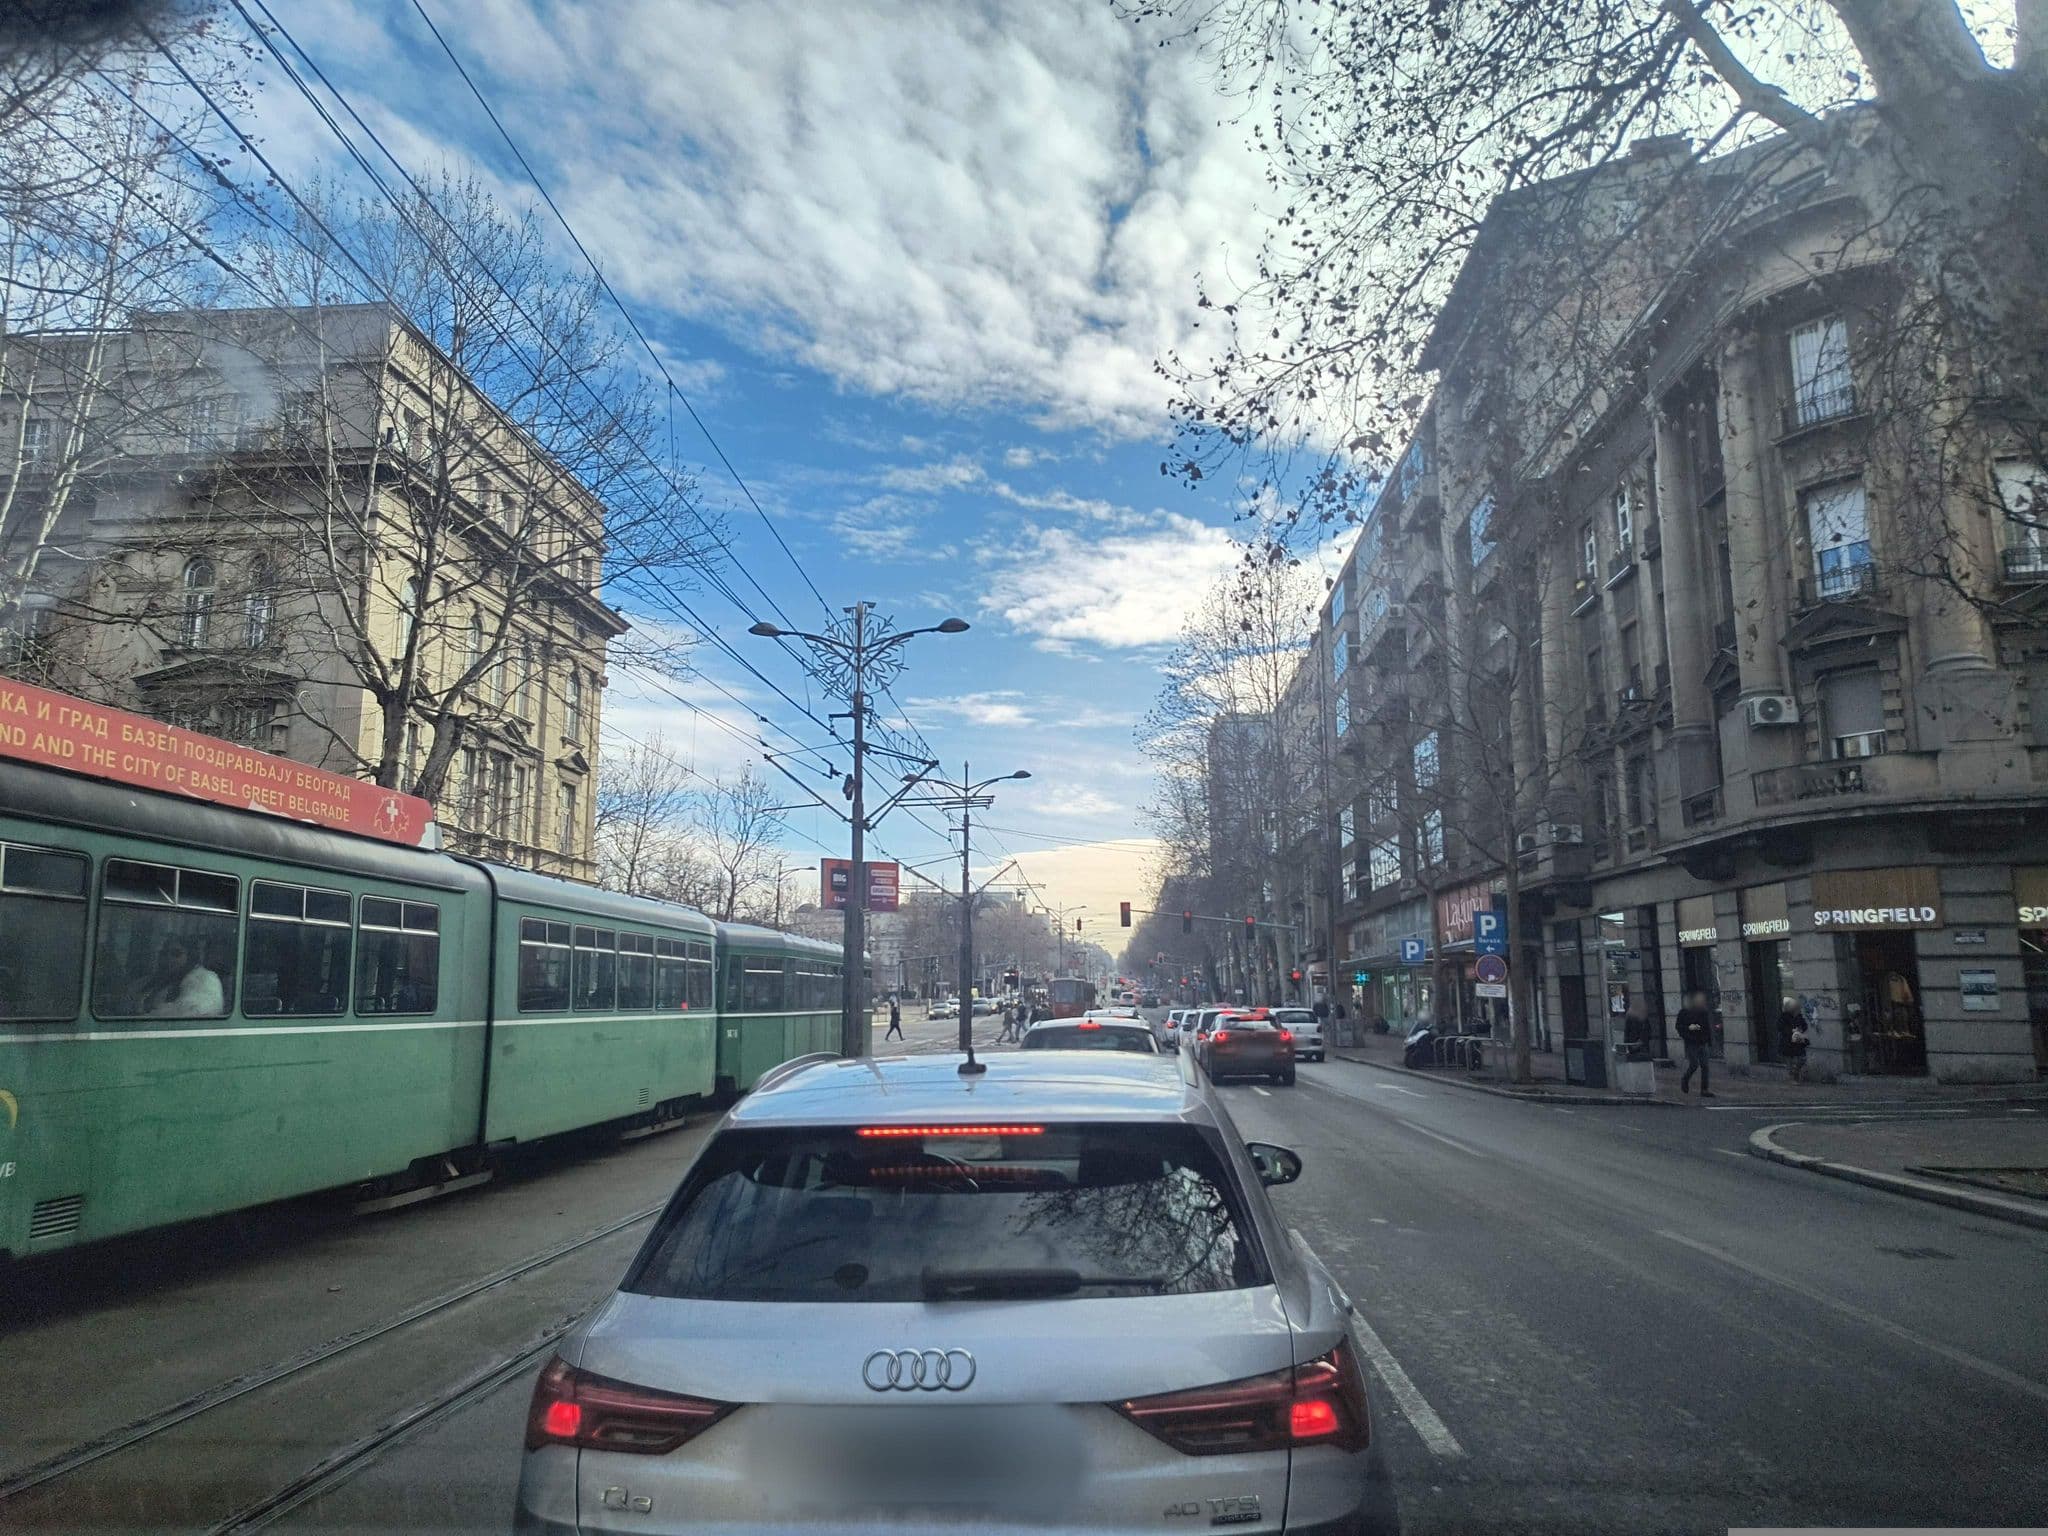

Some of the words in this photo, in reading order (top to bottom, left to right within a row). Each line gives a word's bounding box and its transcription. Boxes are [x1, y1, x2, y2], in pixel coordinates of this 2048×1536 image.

[37, 700, 51, 721] И
[58, 706, 109, 740] ГРАД
[122, 724, 178, 754] БАЗЕЛ
[184, 740, 293, 784] ПОЗДРАВЉАЈУ
[296, 772, 352, 803] БЕОГРАД
[32, 732, 75, 758] AND
[81, 743, 117, 769] THE
[123, 754, 161, 778] CITY
[165, 764, 187, 783] OF
[191, 770, 237, 797] BASEL
[241, 783, 286, 808] GREET
[288, 795, 351, 823] BELGRADE
[1480, 914, 1497, 937] P
[1814, 906, 1936, 926] SPRINGFIELD
[1678, 927, 1717, 943] SPRINGFIELD
[1743, 918, 1790, 937] SPRINGFIELD
[1405, 940, 1420, 960] P
[600, 1485, 652, 1513] Q3
[1205, 1494, 1260, 1513] TFSI
